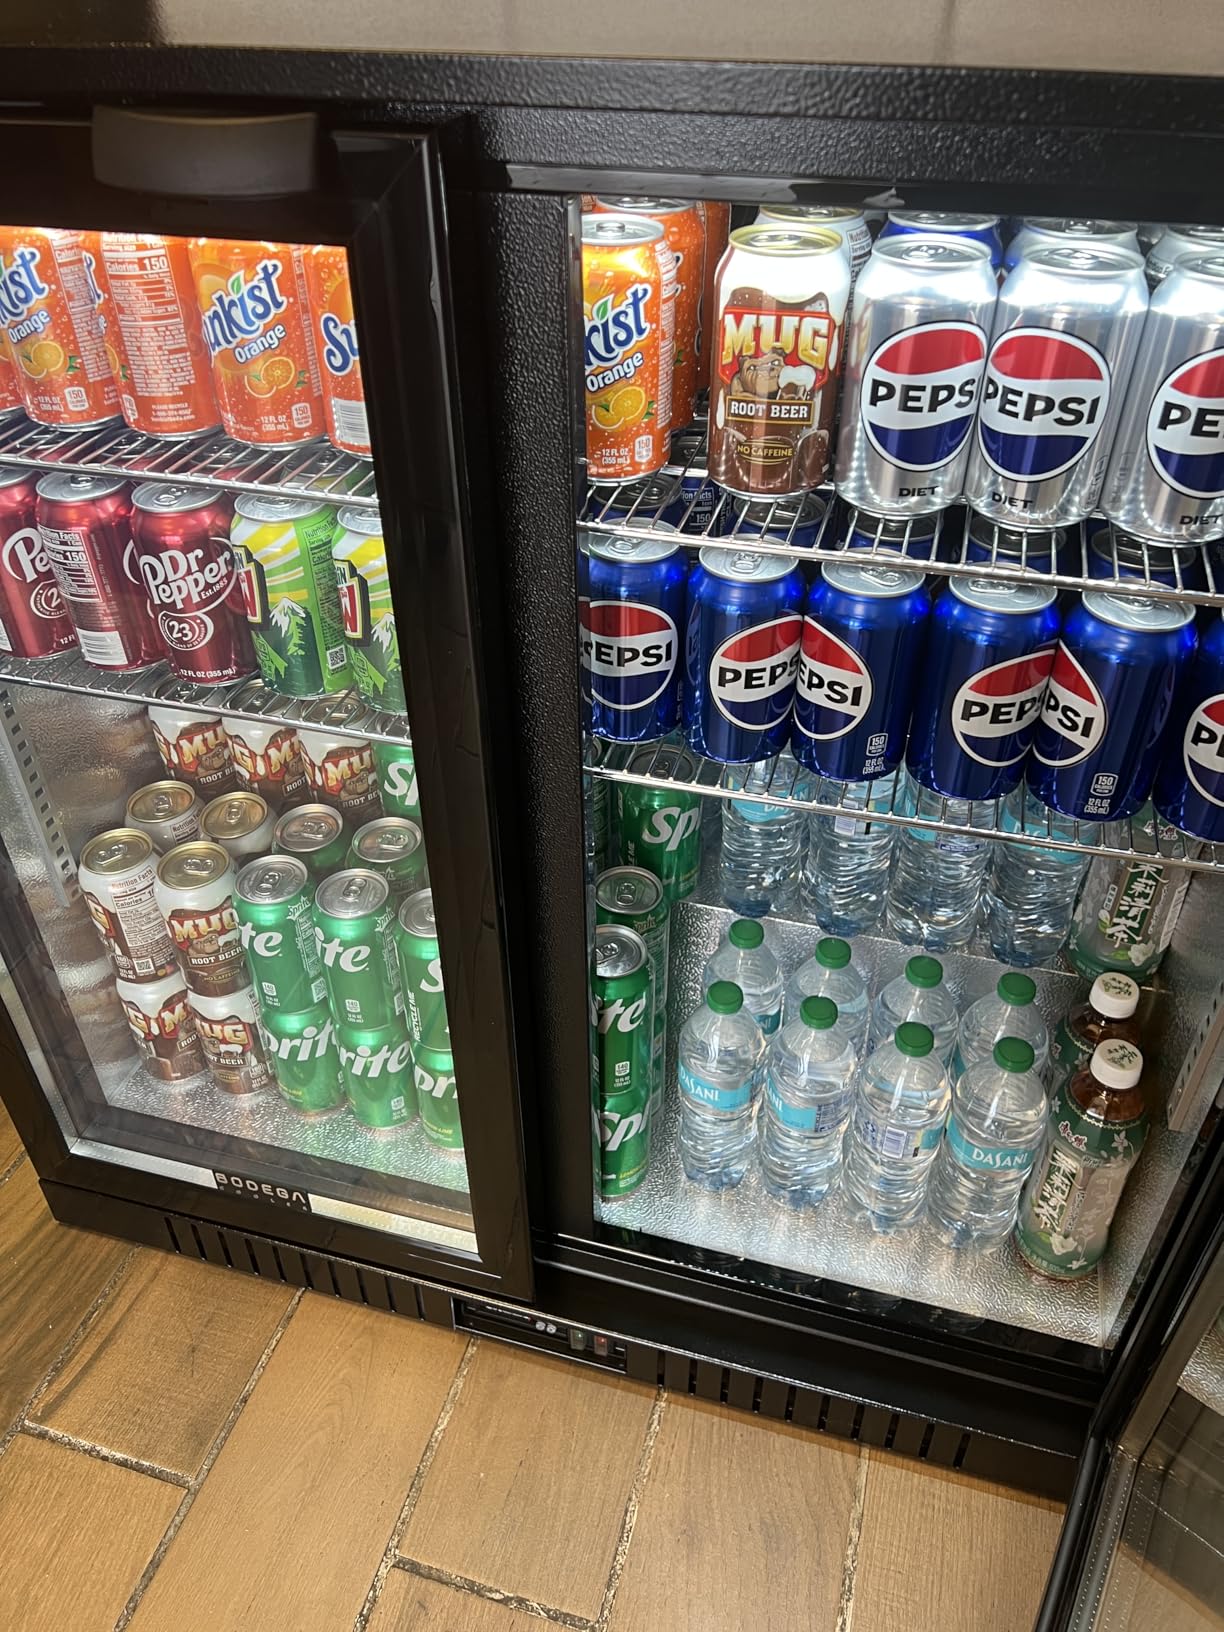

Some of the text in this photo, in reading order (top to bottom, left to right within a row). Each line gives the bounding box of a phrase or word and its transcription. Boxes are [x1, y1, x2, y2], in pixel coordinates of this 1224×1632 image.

[143, 257, 168, 271] 150
[8, 310, 50, 344] Orange
[234, 325, 286, 365] Orange
[722, 314, 829, 370] MUG
[587, 352, 643, 391] Orange
[294, 406, 308, 415] 150
[730, 401, 808, 418] ROOT BEER
[637, 437, 651, 448] 150
[620, 448, 628, 456] OZ
[737, 445, 793, 457] NO CAFFEINE
[898, 485, 938, 497] DIET
[992, 491, 1033, 509] DIET
[1180, 513, 1221, 525] DIET
[65, 551, 87, 561] 150
[159, 549, 204, 582] Dr
[140, 551, 231, 609] Pepper
[168, 620, 193, 641] 23
[872, 736, 885, 746] 150
[199, 771, 223, 785] ROOT
[285, 776, 307, 792] ROOT
[1098, 776, 1114, 785] 150
[342, 796, 366, 808] ROOT
[1088, 798, 1095, 806] 12
[111, 869, 153, 890] Nutrition Facts
[115, 897, 143, 908] Calories
[191, 946, 243, 965] ROOT BEER
[408, 991, 421, 1043] RECYCLE ME
[679, 1068, 720, 1101] DASANI
[972, 1148, 1028, 1168] DASANI
